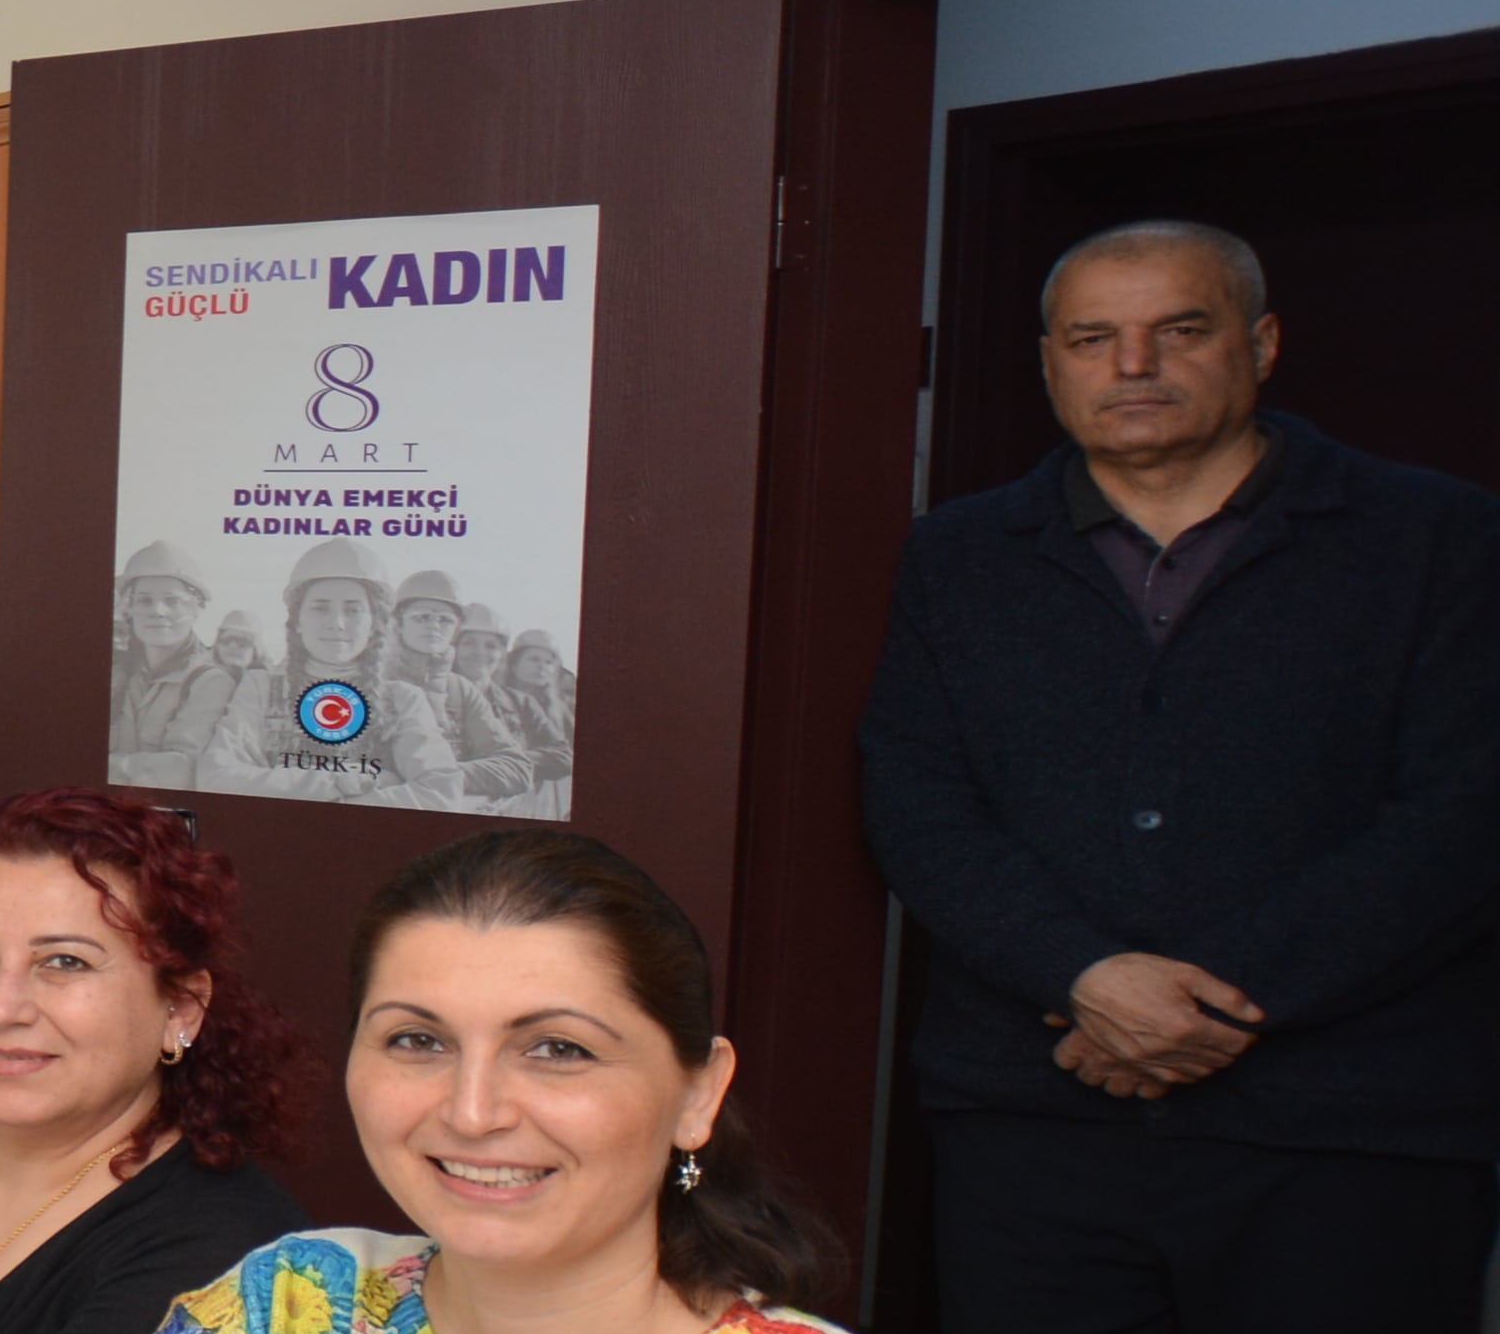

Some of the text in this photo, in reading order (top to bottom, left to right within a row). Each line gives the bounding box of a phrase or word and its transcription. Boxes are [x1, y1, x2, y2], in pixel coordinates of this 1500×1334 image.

[144, 244, 567, 310] SENDİKALI KADIN
[143, 292, 251, 322] GÜÇLÜ
[304, 343, 381, 433] 8
[272, 441, 420, 464] MART
[232, 484, 459, 513] DÜNYA EMEKÇİ
[222, 514, 469, 539] KADINLAR GÜNÜ
[279, 750, 382, 780] TÜRK-İŞ
